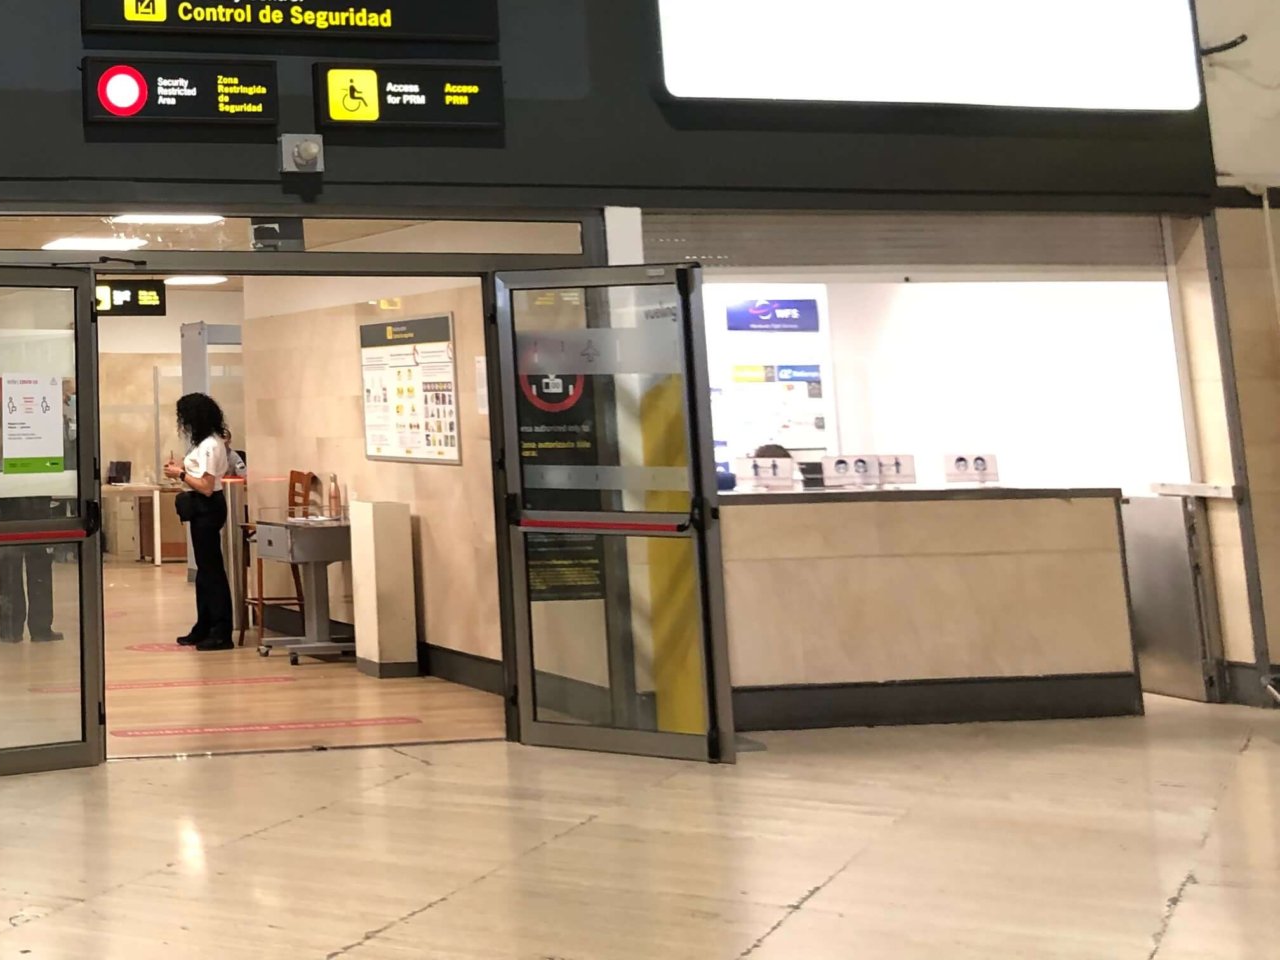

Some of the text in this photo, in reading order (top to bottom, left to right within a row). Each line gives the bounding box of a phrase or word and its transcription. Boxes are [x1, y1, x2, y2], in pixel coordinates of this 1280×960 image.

[177, 2, 392, 29] Control de Seguridad
[157, 77, 189, 88] Security
[217, 75, 239, 85] Zona
[157, 86, 197, 96] Restricted
[217, 84, 267, 95] Restringida
[386, 82, 420, 93] Access
[444, 83, 479, 93] Acceso
[158, 95, 177, 105] Area
[218, 94, 230, 103] de
[386, 94, 426, 105] for PRM
[445, 95, 469, 105] PRM
[218, 103, 263, 113] Seguridad
